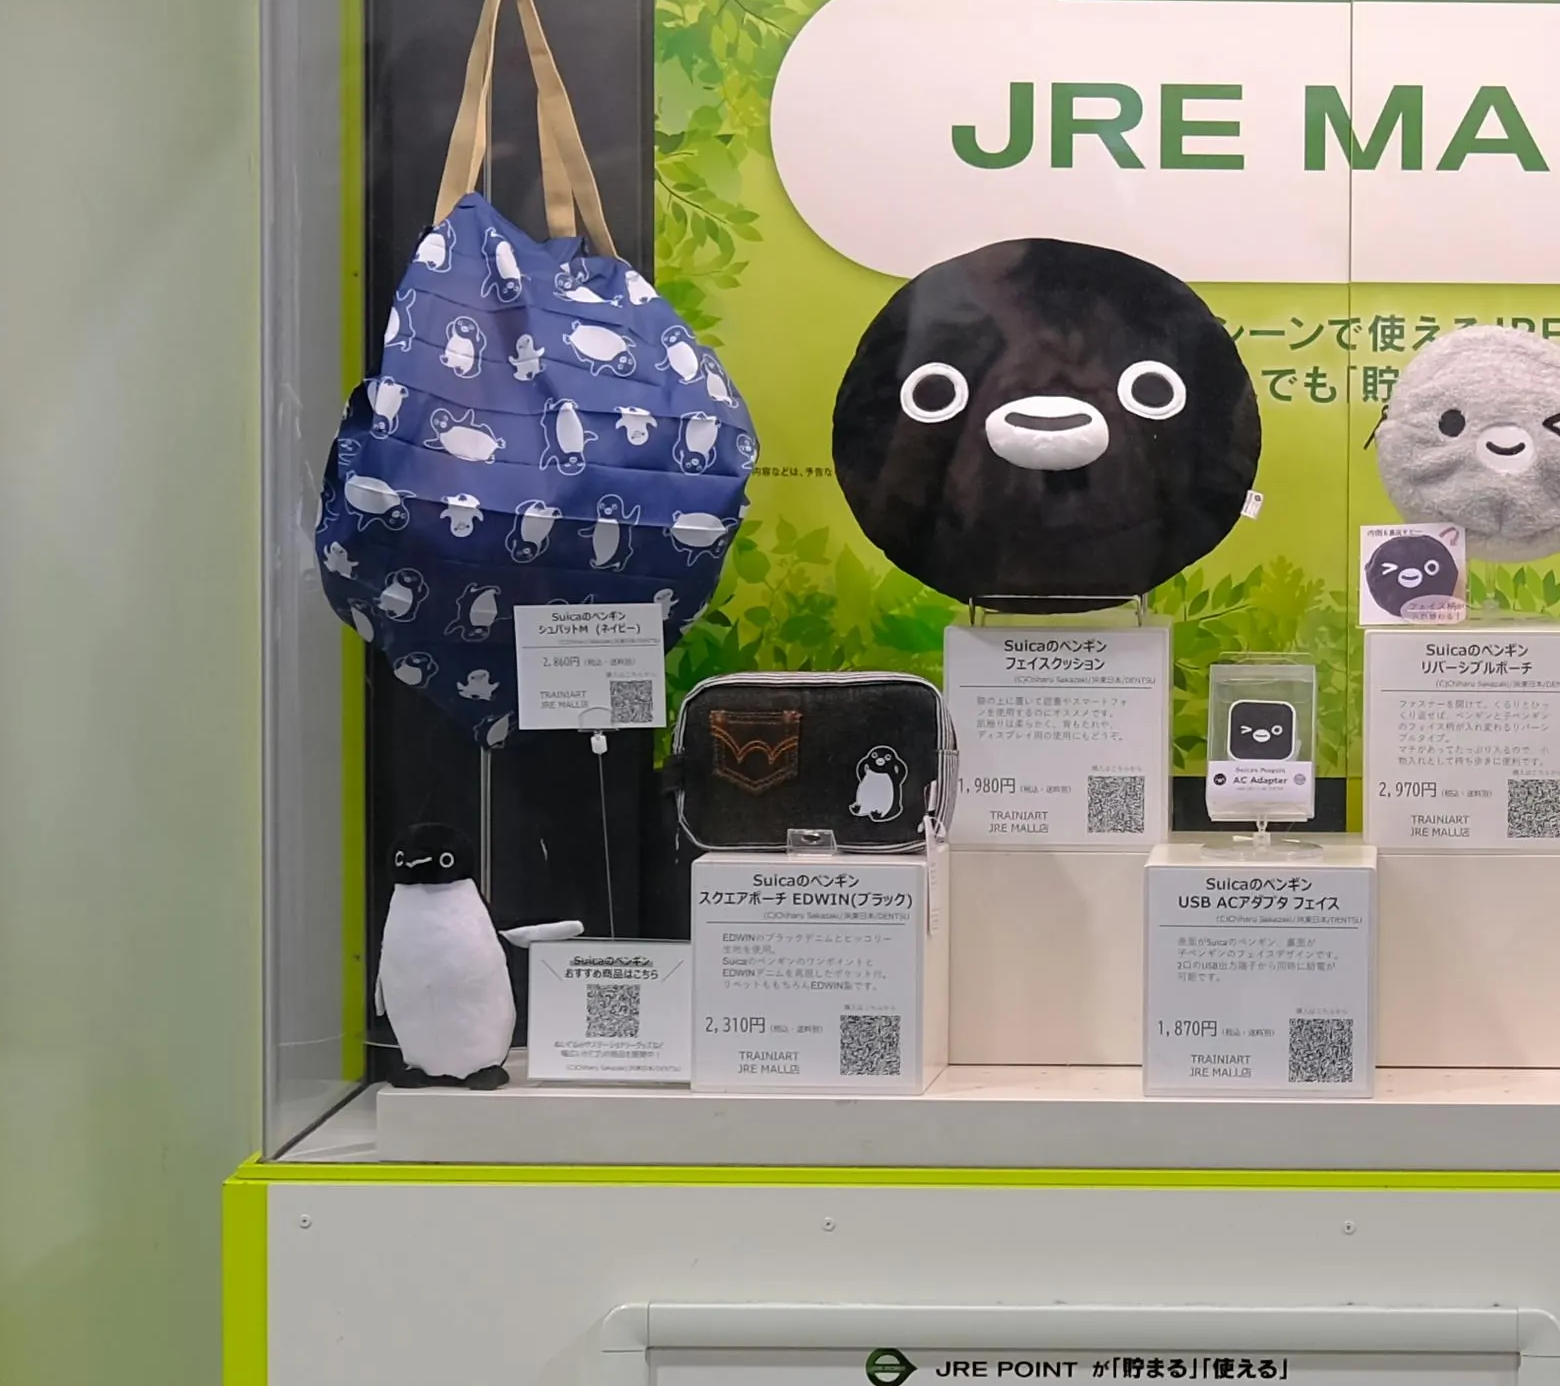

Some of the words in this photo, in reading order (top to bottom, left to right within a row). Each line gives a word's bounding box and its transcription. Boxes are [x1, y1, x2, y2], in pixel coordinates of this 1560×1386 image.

[951, 81, 1244, 171] JRE
[552, 612, 626, 621] Suicaのペンギン
[1004, 640, 1107, 652] Suicaのペンギン
[1426, 644, 1528, 657] Suicaのペンギン
[1006, 658, 1105, 670] フェイスクッション
[1421, 661, 1532, 675] リバーシブルポーチ
[958, 778, 1015, 794] 1,980円
[1251, 776, 1288, 784] Adapter
[1379, 782, 1436, 797] 2,970円
[991, 811, 1048, 819] TRAINIART
[1412, 815, 1469, 824] TRAINIART
[990, 824, 1006, 832] JRE
[1411, 828, 1428, 836] JRE
[753, 874, 860, 887] Suicaのペンギン
[1206, 878, 1312, 892] Suicaのペンギン
[699, 892, 787, 905] スクエアポーチ
[793, 892, 913, 908] EDWIN(ブラック)
[1178, 897, 1211, 908] USB
[1217, 896, 1288, 909] ACアダプタ
[1294, 898, 1339, 910] フェイス
[705, 1017, 765, 1034] 2,310円
[1158, 1021, 1217, 1037] 1,870円
[739, 1052, 798, 1061] TRAINIART
[1192, 1055, 1250, 1063] TRAINIART
[738, 1065, 757, 1074] JRE
[1190, 1068, 1208, 1077] JRE
[936, 1361, 988, 1377] JRE
[997, 1362, 1078, 1378] POINT
[1092, 1358, 1287, 1380] が「貯まる」「使える」
